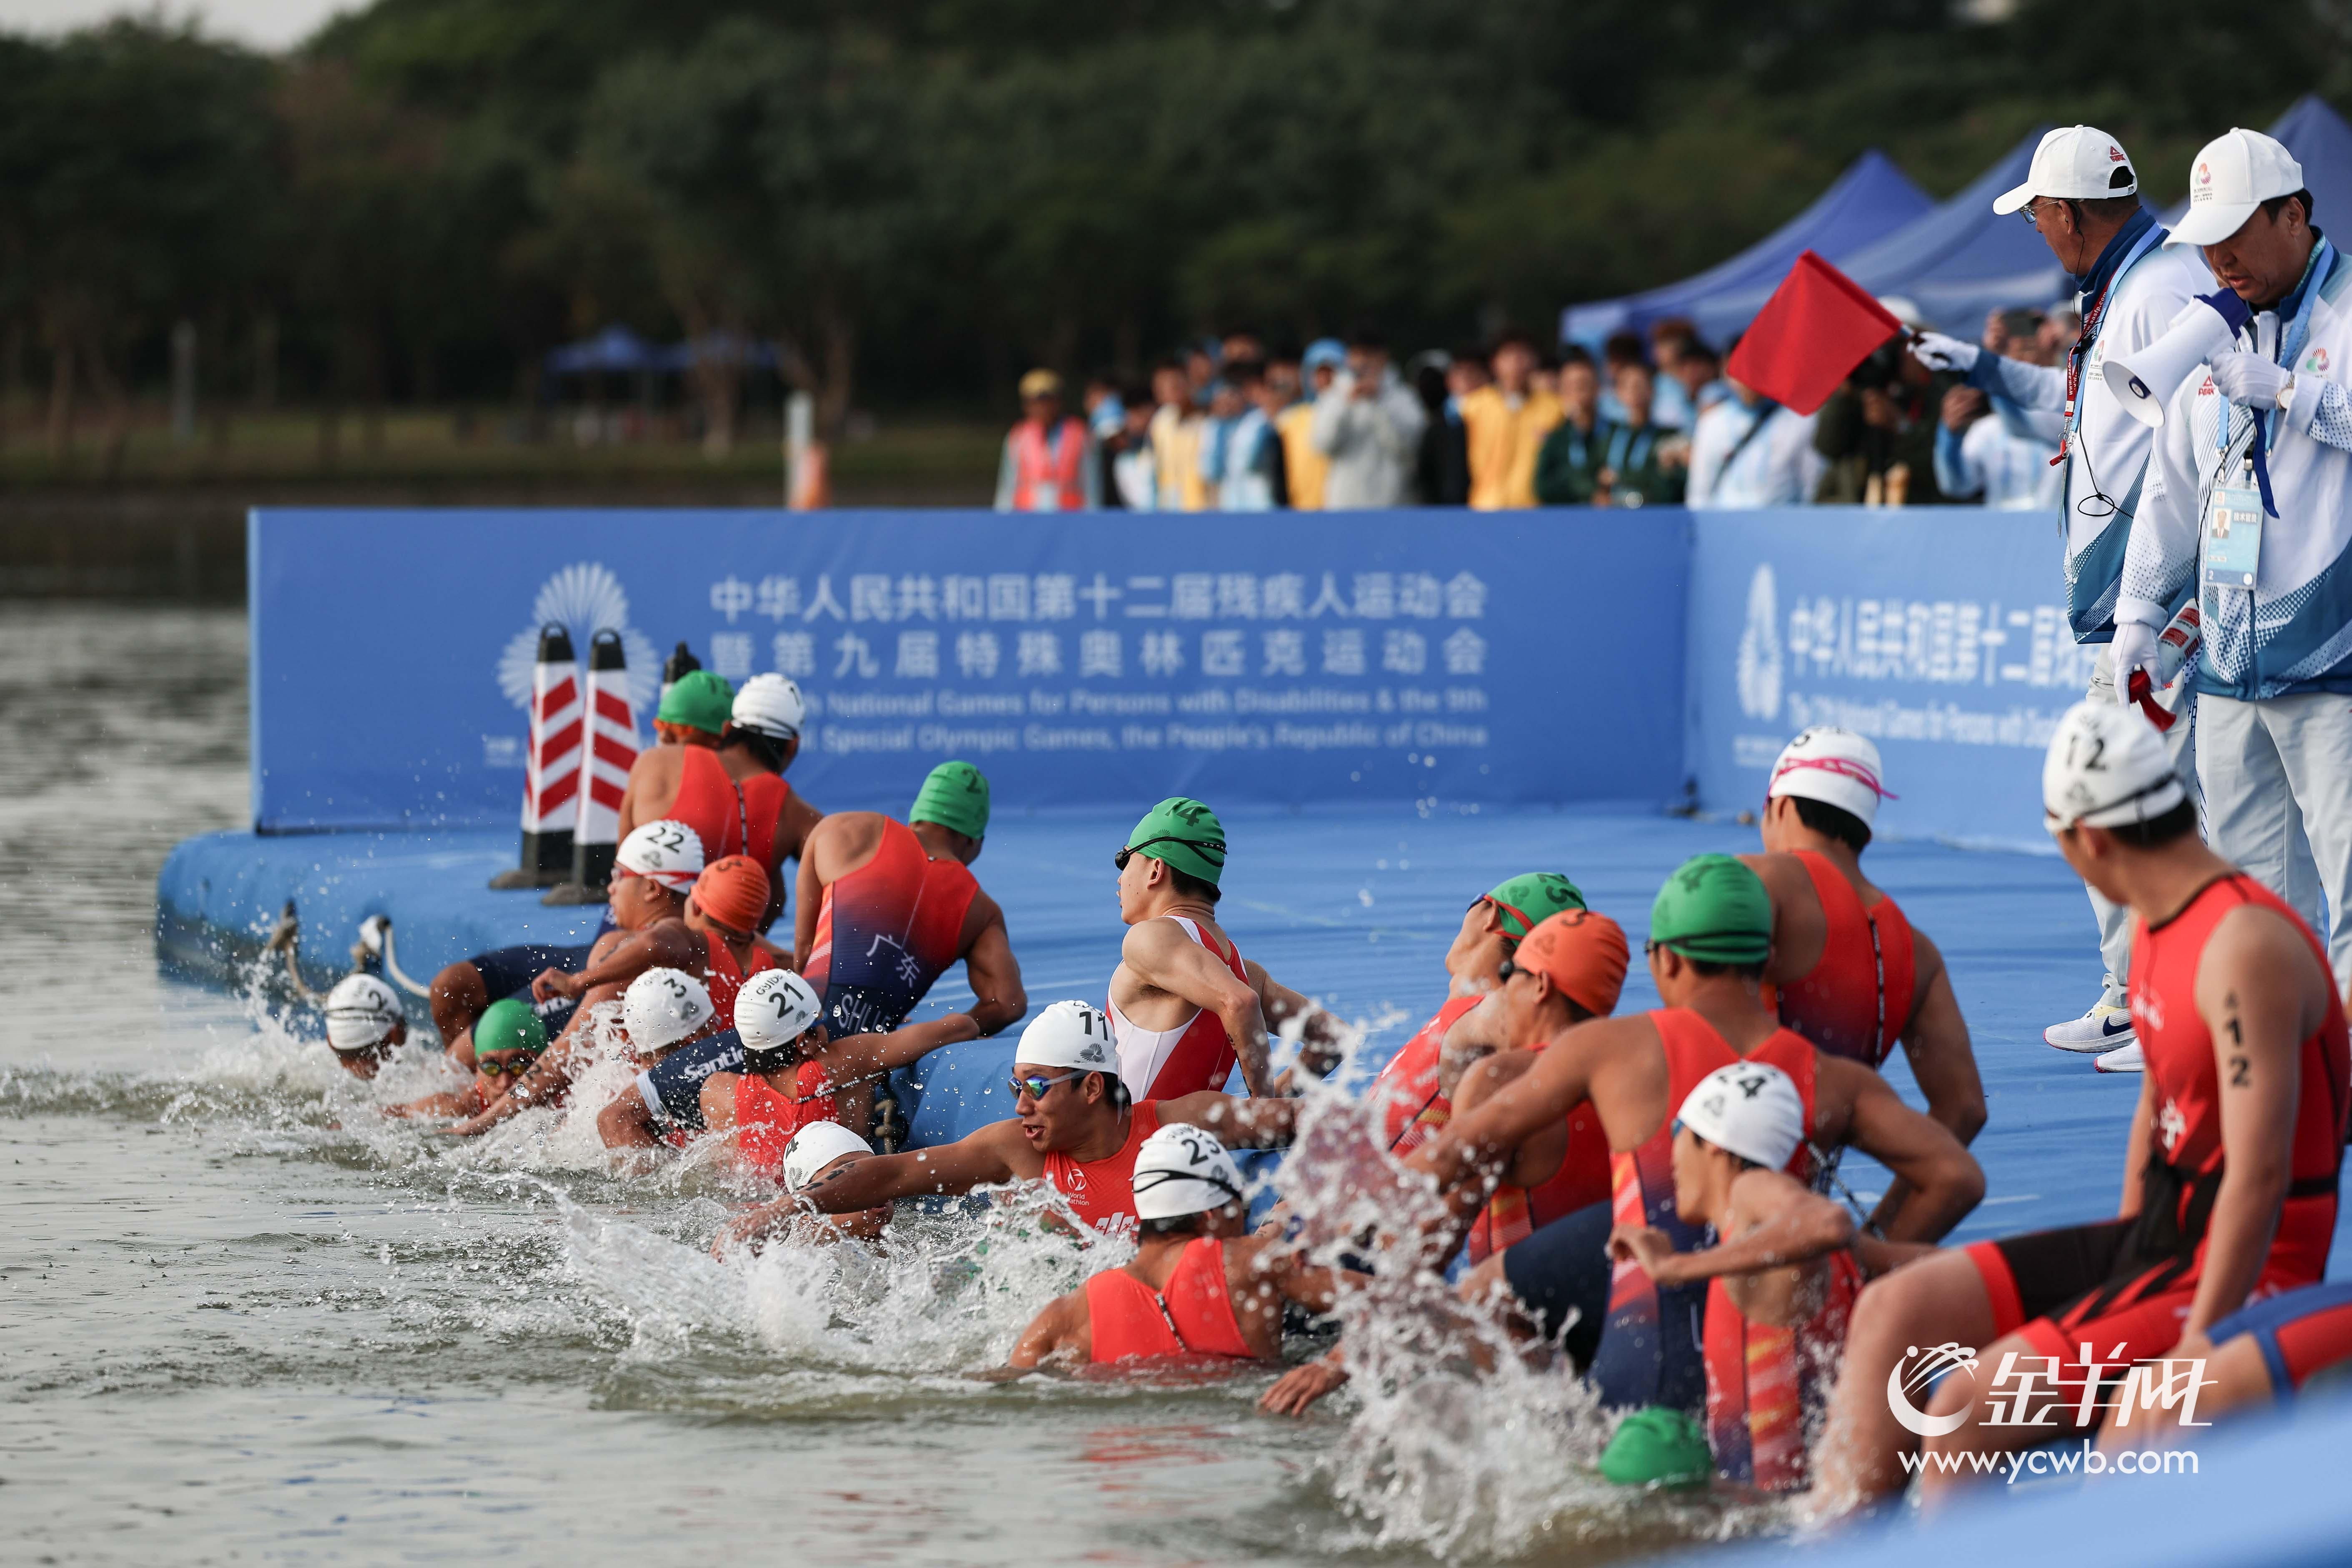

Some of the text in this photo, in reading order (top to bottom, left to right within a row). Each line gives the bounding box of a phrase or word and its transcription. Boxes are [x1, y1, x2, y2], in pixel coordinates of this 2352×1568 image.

[710, 571, 1487, 623] 中华人民共和国第十二届残疾人运动会
[646, 826, 685, 853] 22
[769, 982, 804, 1019] 21
[1079, 1011, 1108, 1041] 11
[1067, 1191, 1085, 1200] World
